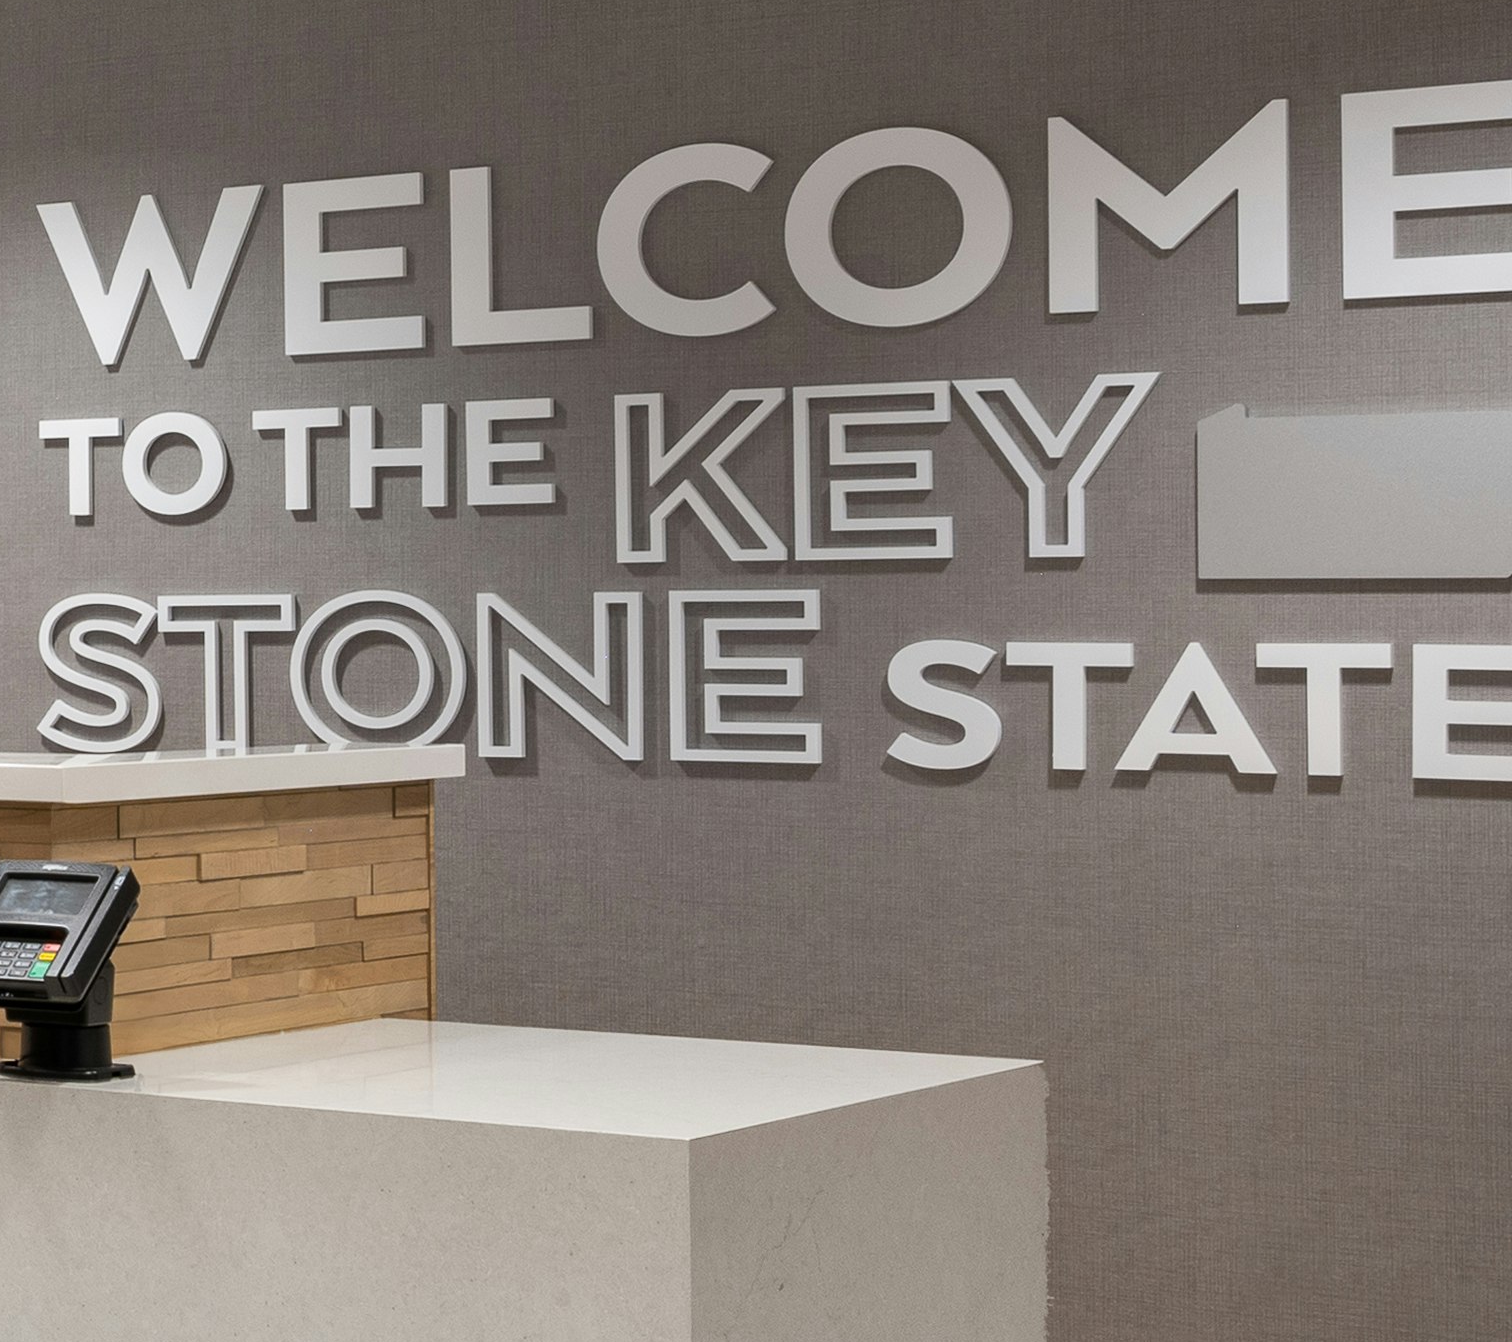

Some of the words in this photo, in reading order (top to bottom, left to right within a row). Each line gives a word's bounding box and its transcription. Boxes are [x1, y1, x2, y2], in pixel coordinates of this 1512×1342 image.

[36, 79, 1512, 366] WELCOME
[39, 411, 229, 517] TO
[252, 397, 556, 512] THE
[614, 370, 1162, 563] KEY
[37, 589, 822, 764] STONE
[886, 639, 1512, 782] STATE
